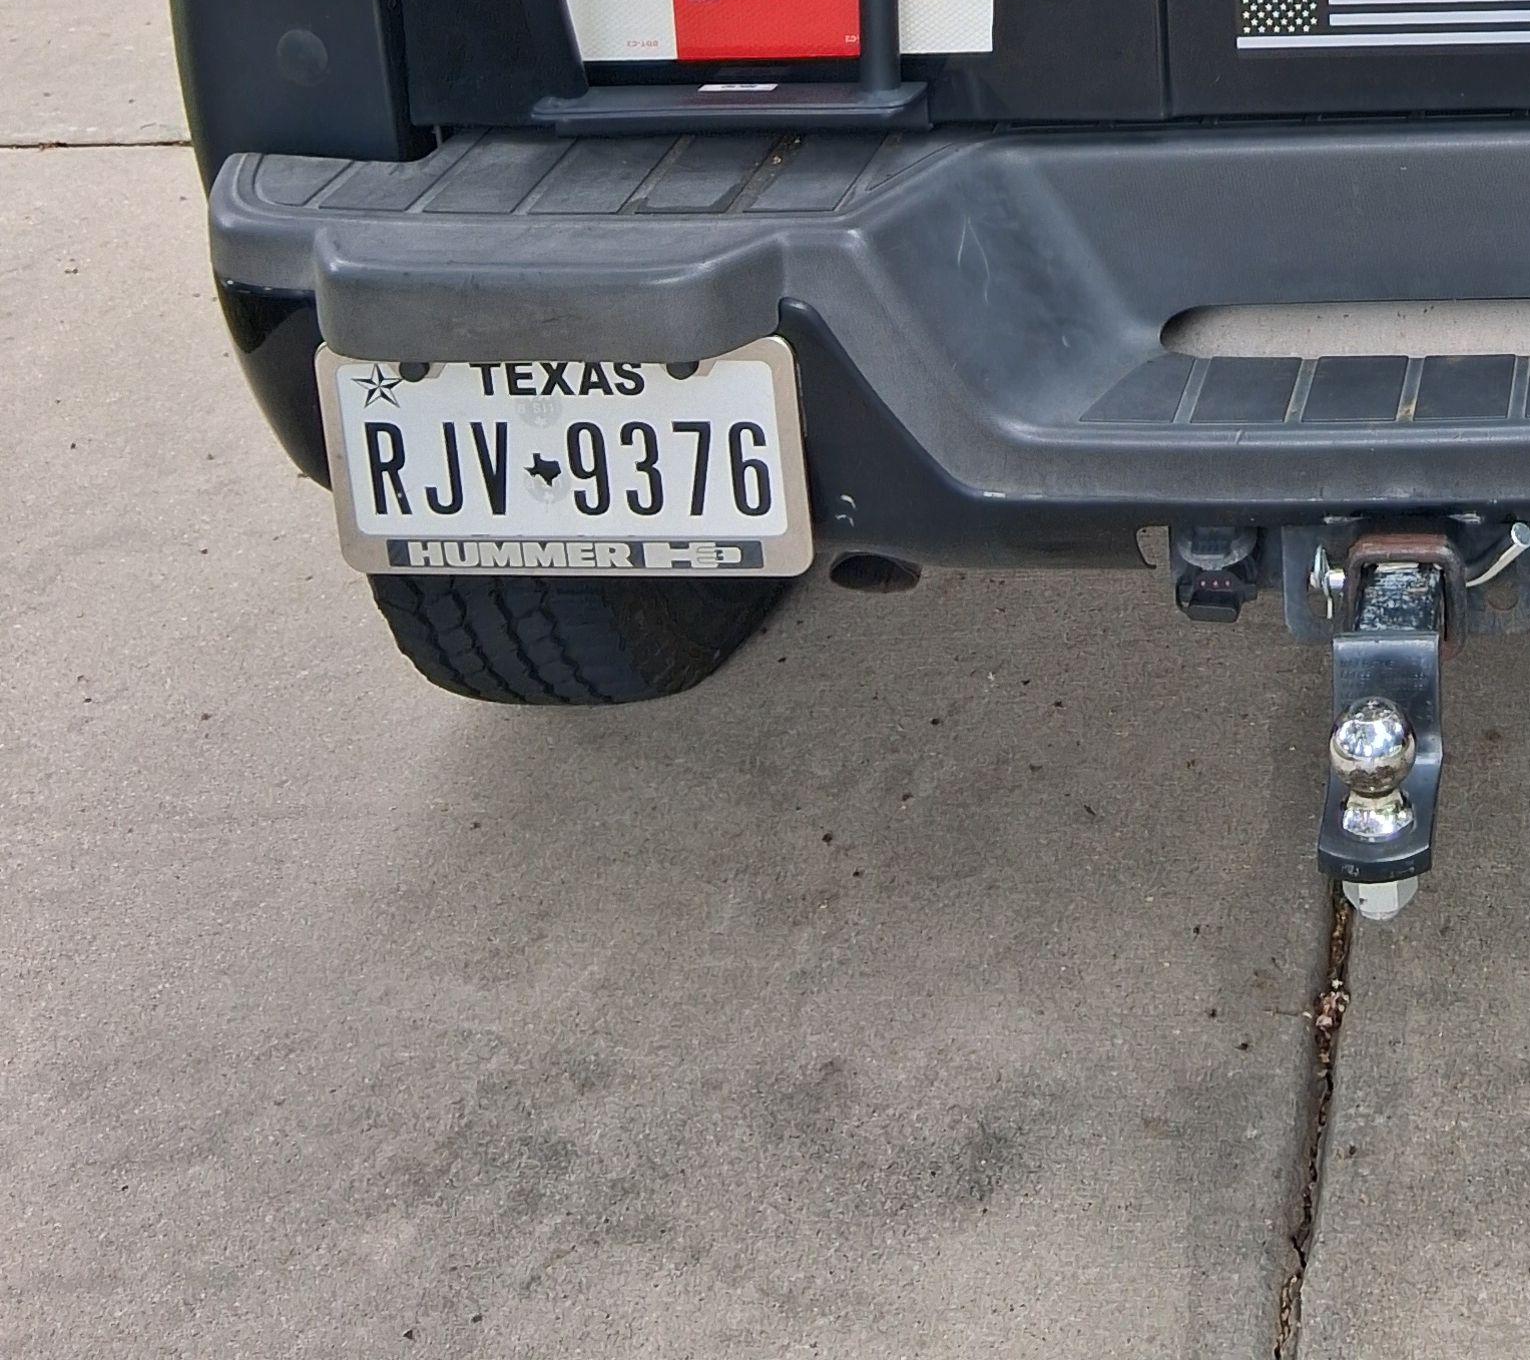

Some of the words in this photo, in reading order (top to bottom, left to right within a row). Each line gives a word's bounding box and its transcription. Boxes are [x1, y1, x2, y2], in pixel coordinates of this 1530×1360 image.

[468, 361, 646, 397] TEXAS
[363, 420, 509, 516] RJV
[566, 420, 772, 517] 9376
[407, 541, 633, 569] HUMMER
